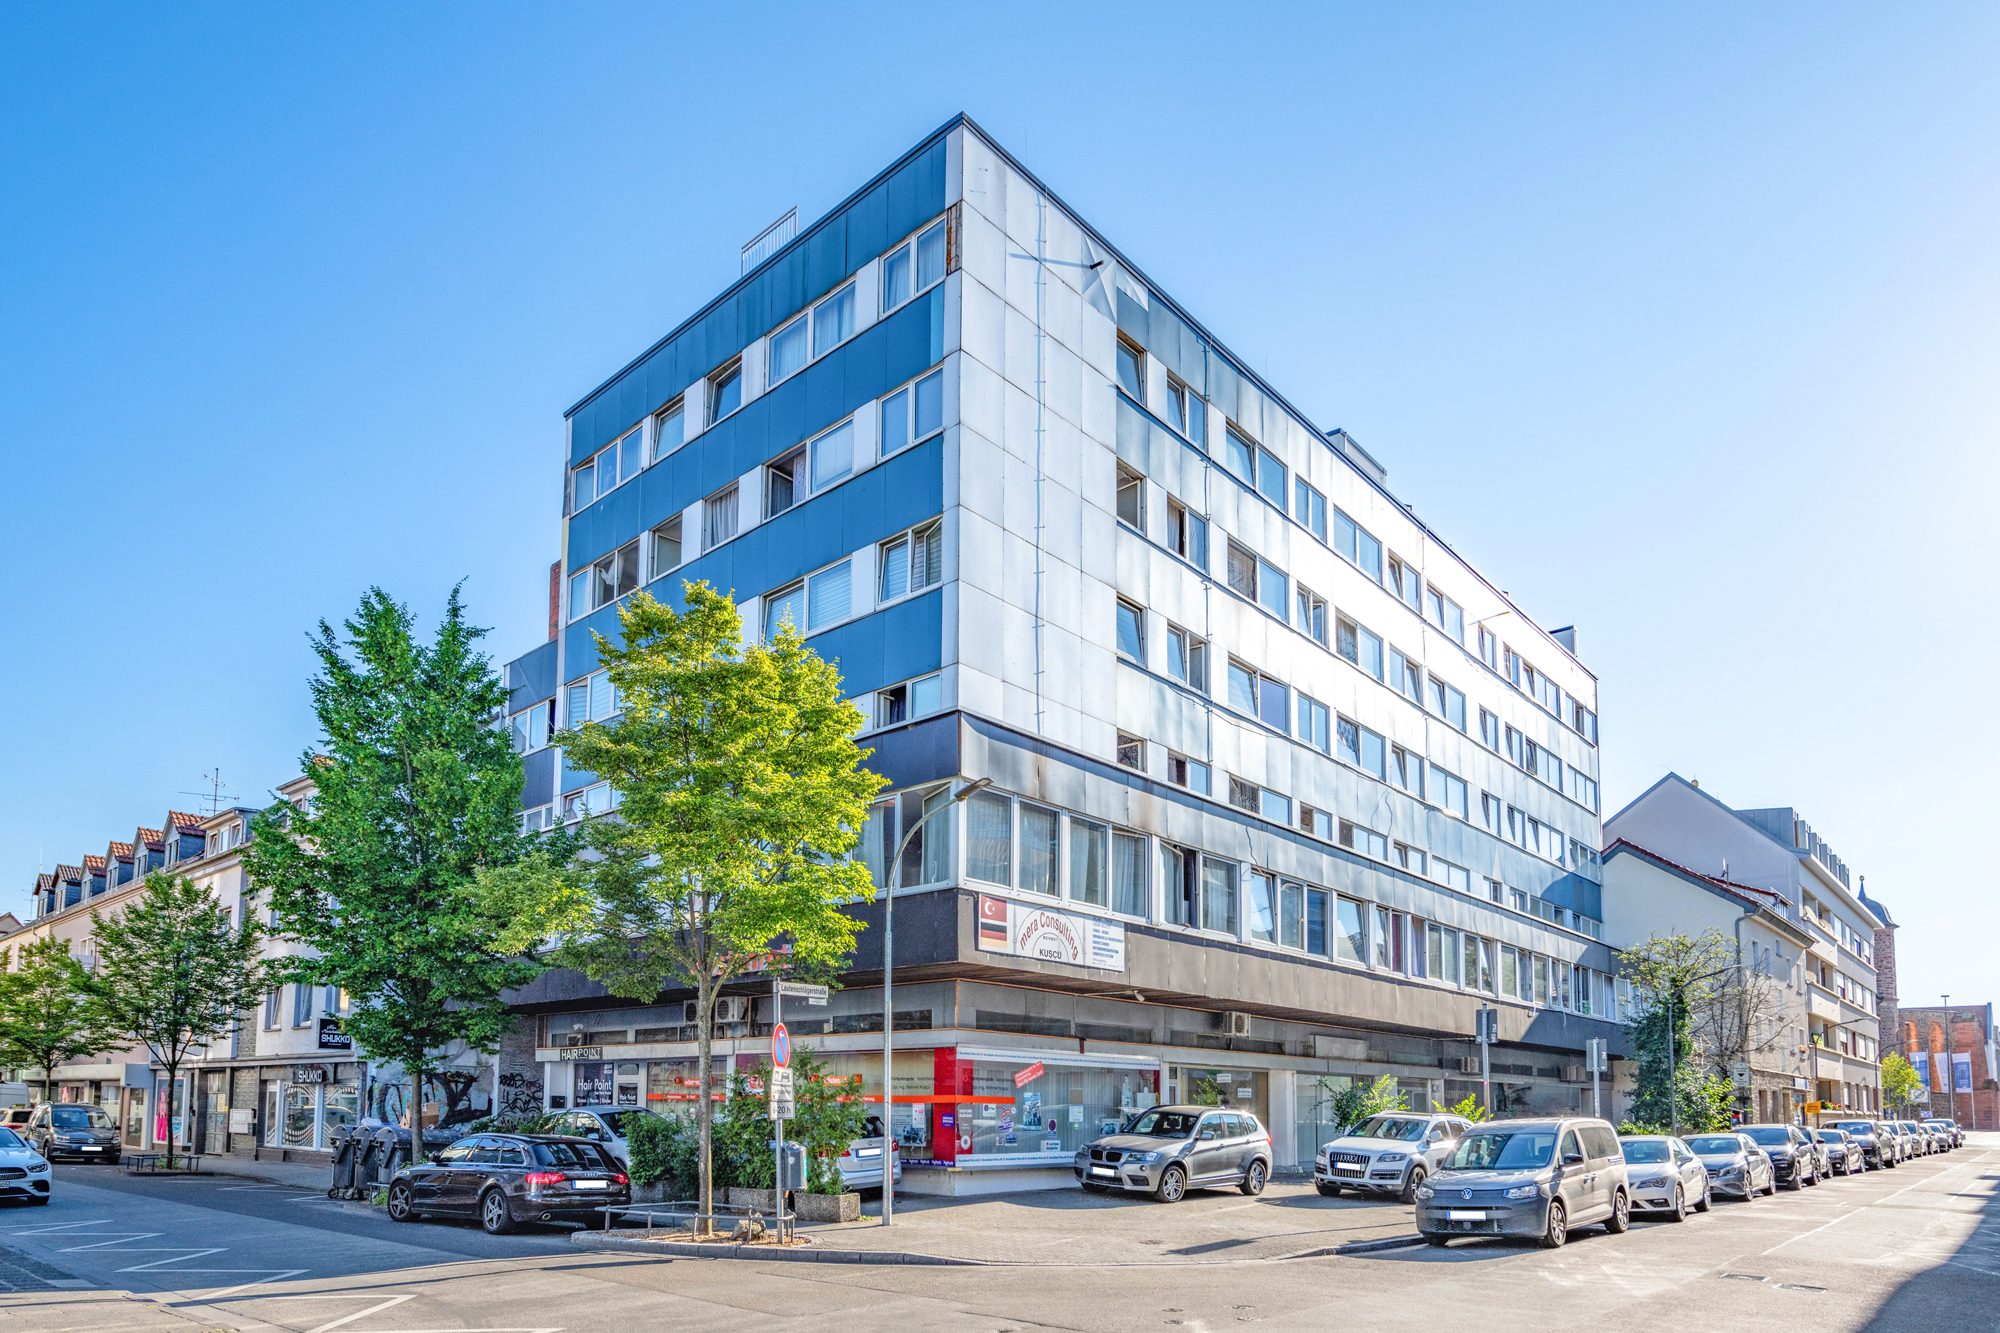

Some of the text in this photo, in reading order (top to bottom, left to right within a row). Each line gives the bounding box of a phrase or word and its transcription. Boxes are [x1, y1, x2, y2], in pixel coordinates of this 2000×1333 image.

[1019, 911, 1079, 961] mera Consulting
[780, 984, 828, 996] Lautenschlägerstraße
[321, 1034, 350, 1043] SHUKKO
[298, 1070, 323, 1082] SHUKKO
[577, 1078, 612, 1091] Hair Point
